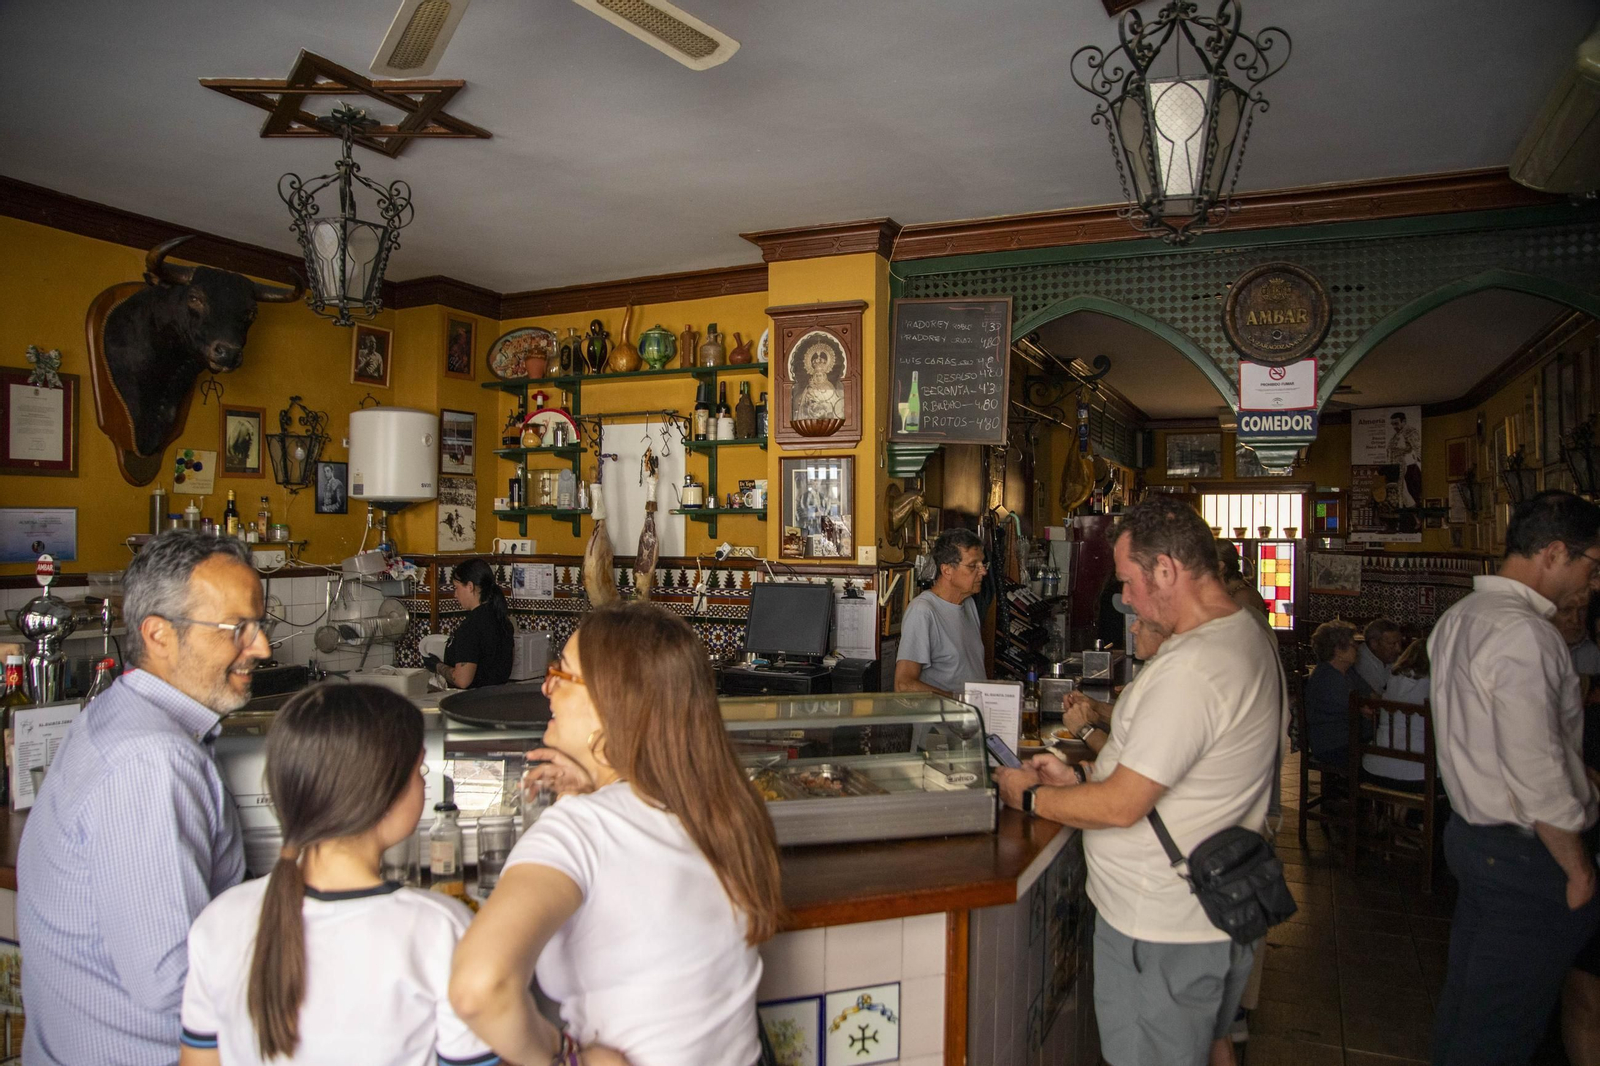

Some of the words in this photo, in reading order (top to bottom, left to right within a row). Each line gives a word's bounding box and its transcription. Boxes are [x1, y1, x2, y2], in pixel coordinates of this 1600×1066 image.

[1246, 308, 1308, 326] AMBAR
[899, 357, 922, 366] LUIS
[924, 356, 957, 367] CAÑAS
[923, 415, 968, 429] PROTOS
[1241, 414, 1313, 432] COMEDOR
[37, 563, 54, 571] AMBAR
